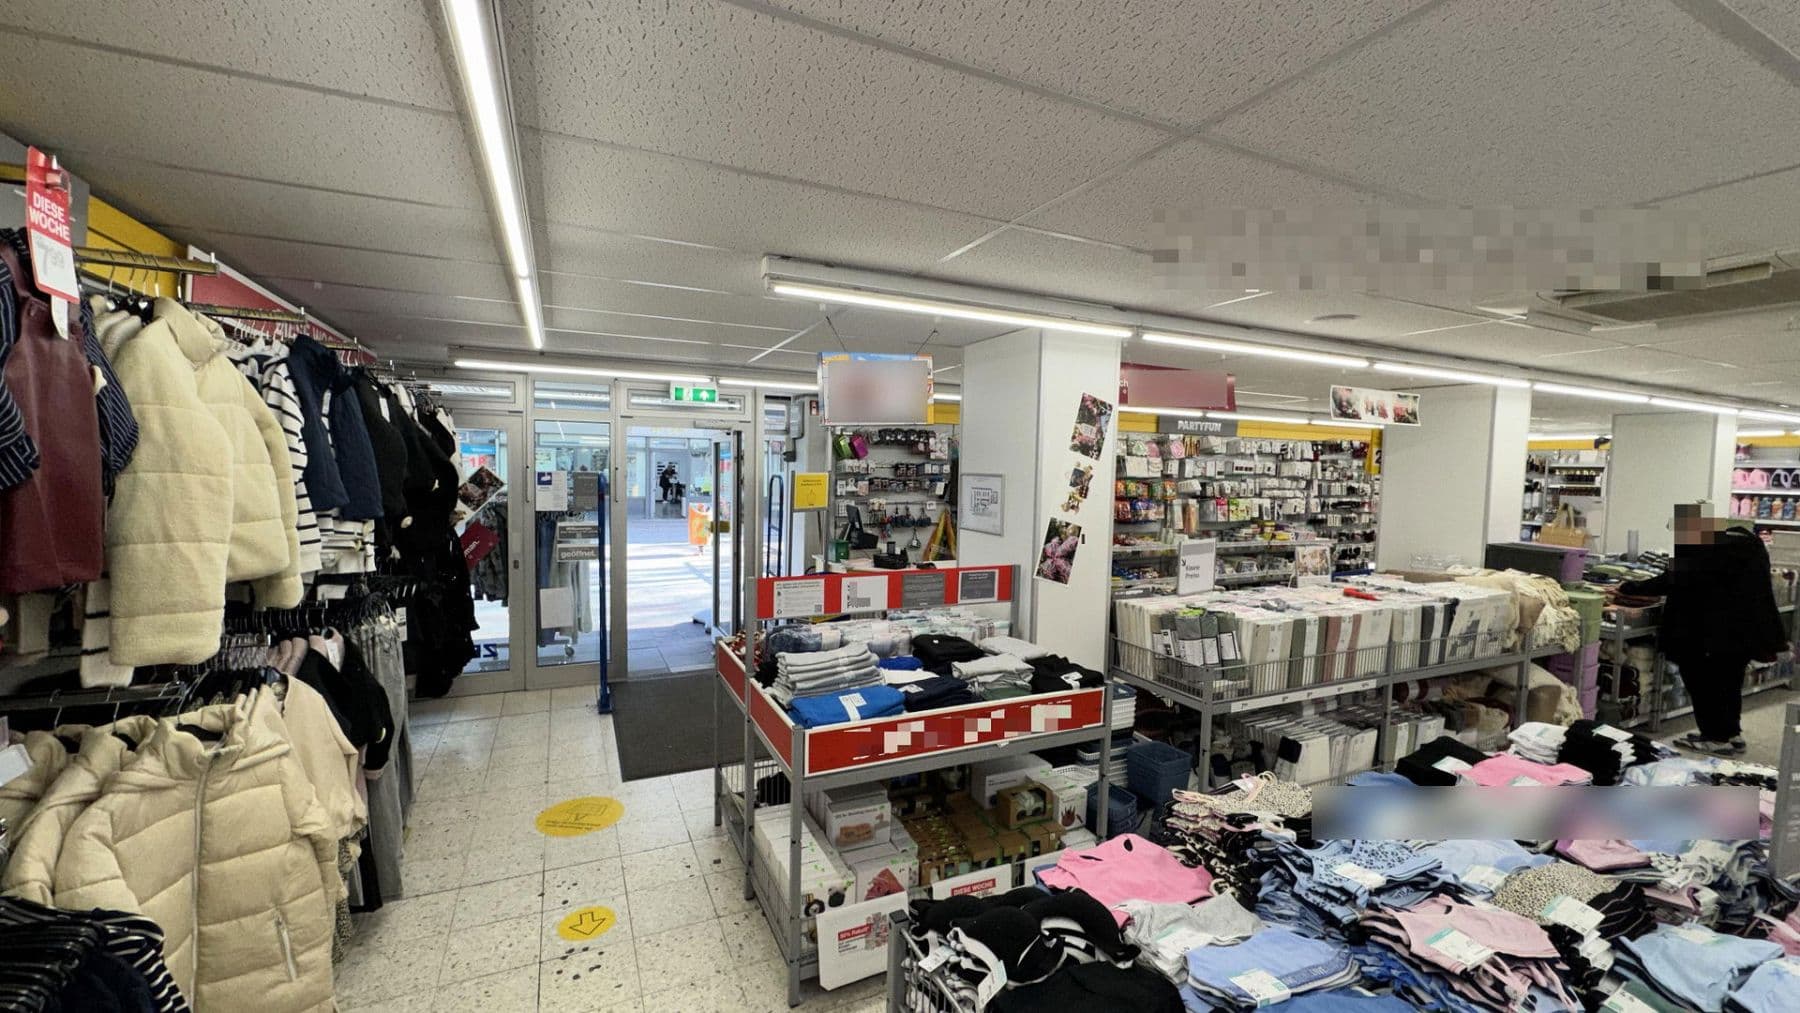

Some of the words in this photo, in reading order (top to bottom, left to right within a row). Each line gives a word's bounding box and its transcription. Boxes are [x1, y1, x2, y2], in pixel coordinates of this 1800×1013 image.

[33, 191, 65, 223] DIESE
[29, 206, 71, 242] WOCHE
[1177, 420, 1222, 433] PARTYFUN
